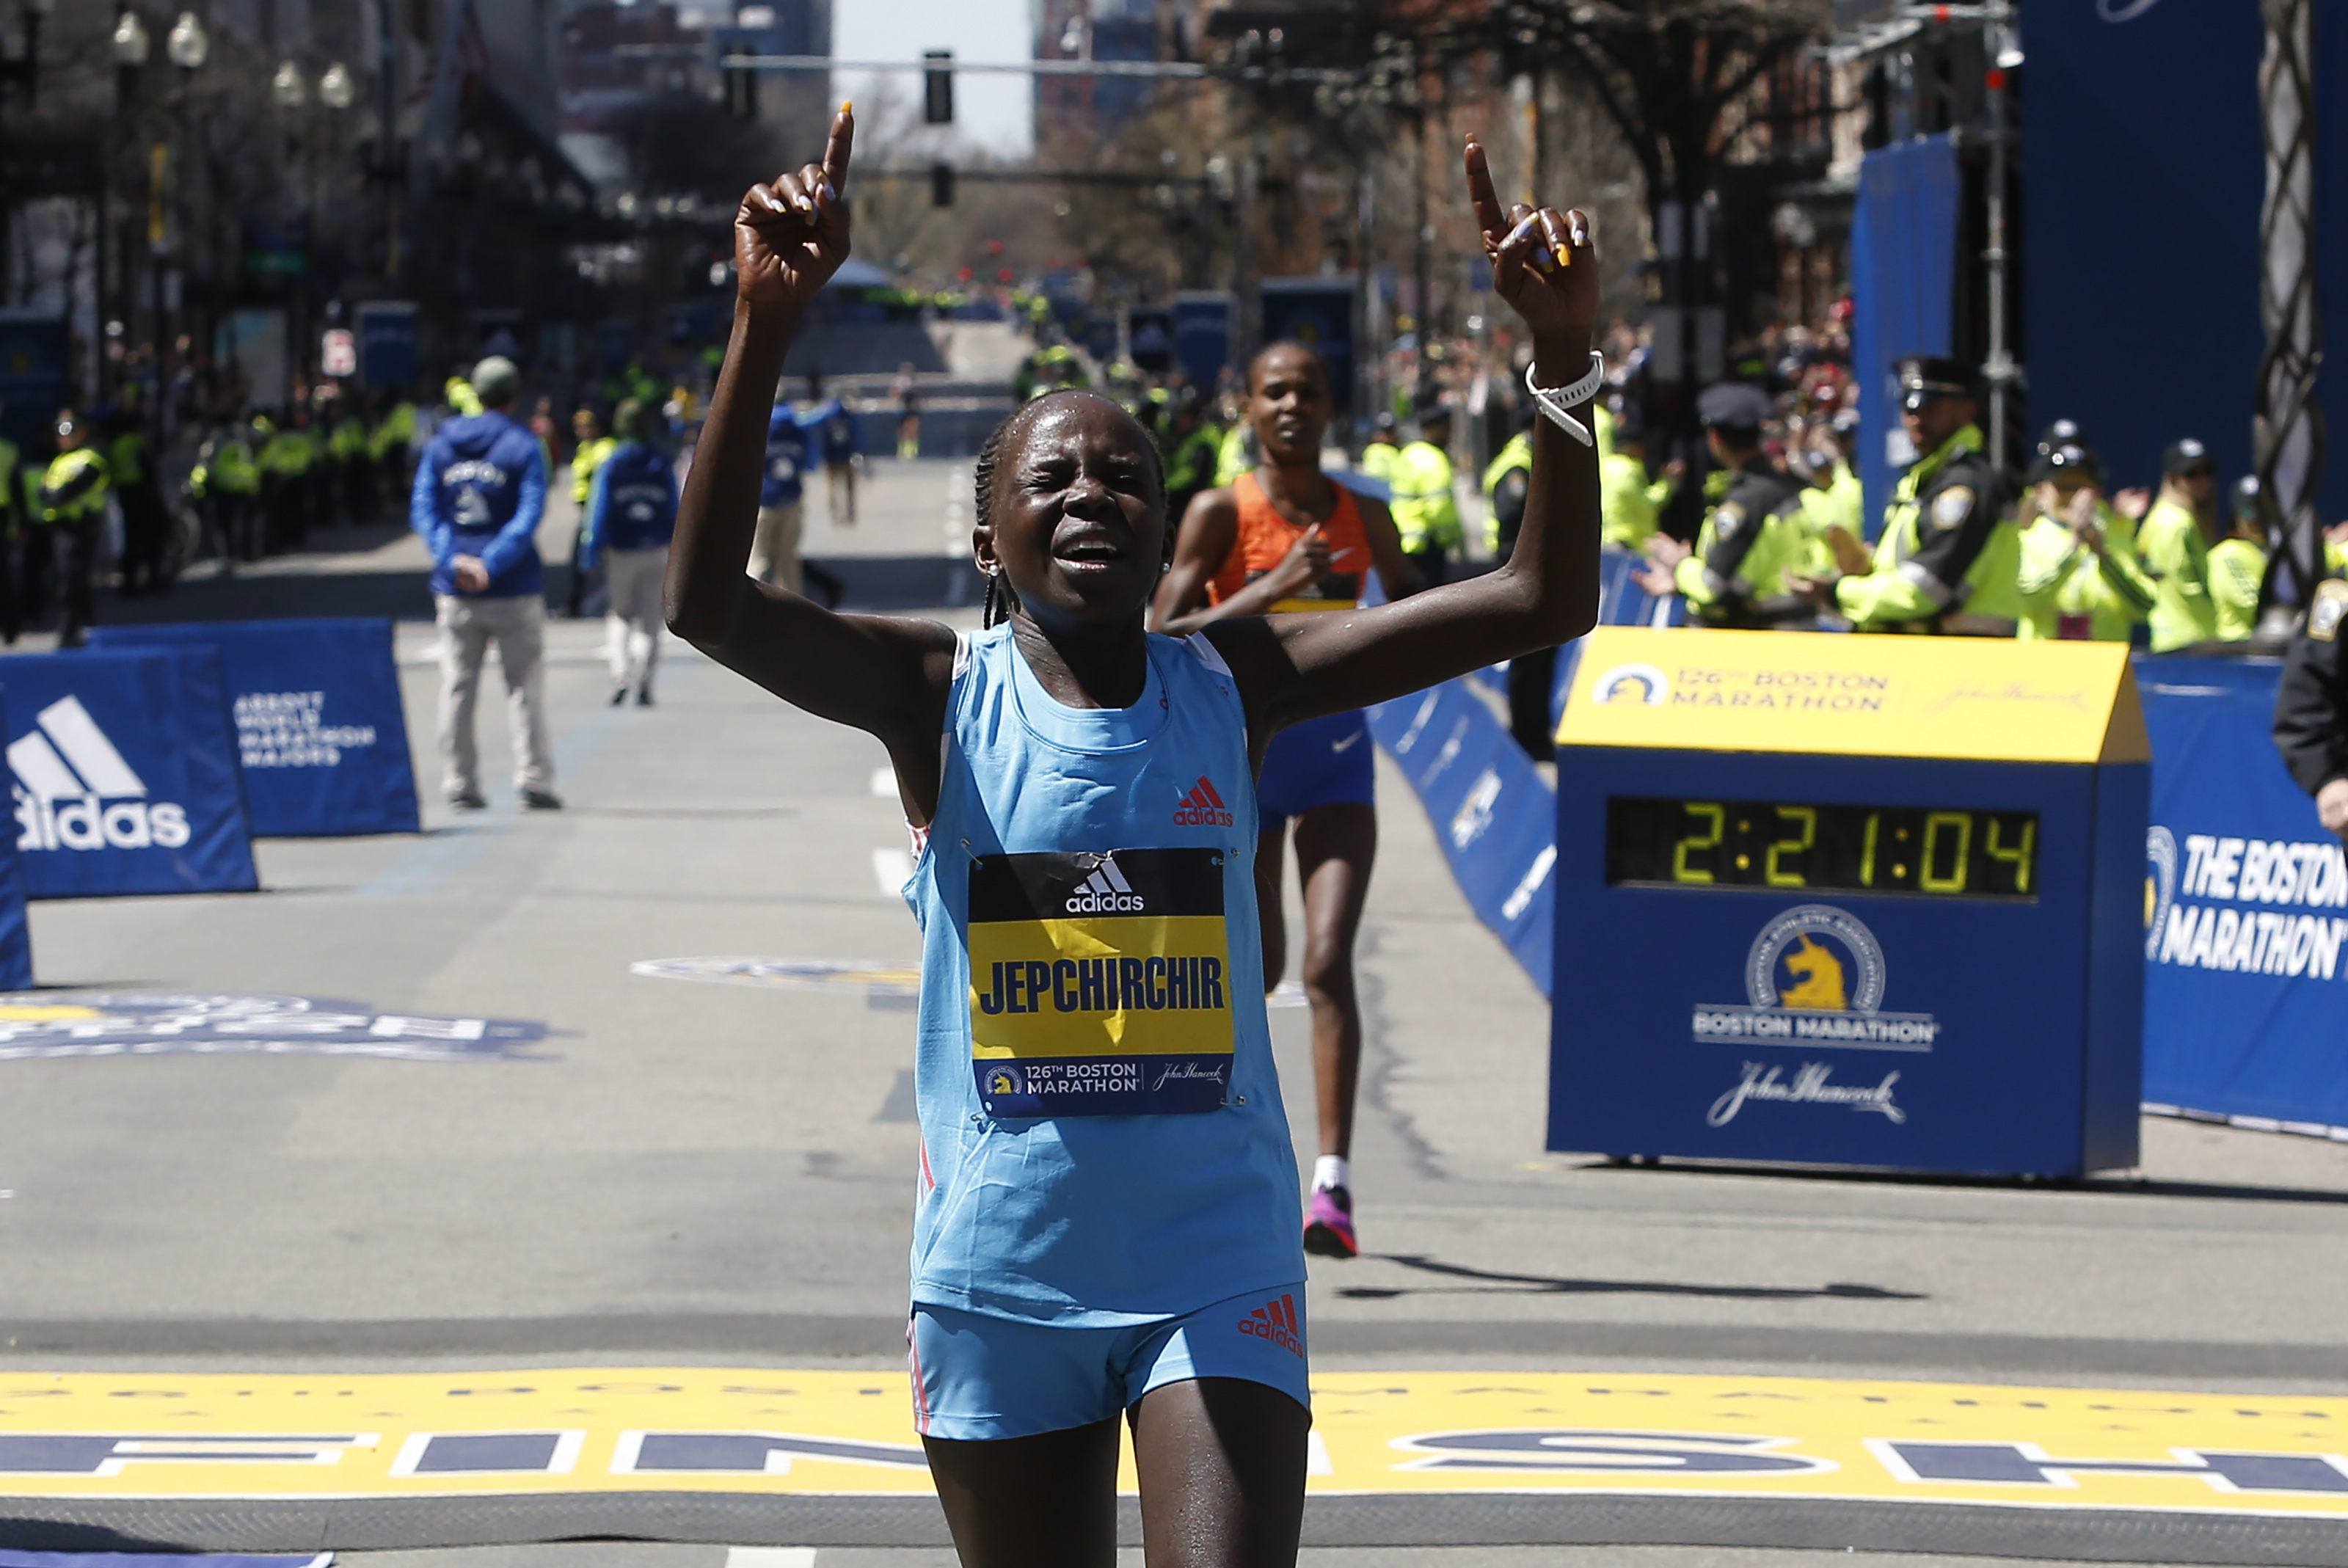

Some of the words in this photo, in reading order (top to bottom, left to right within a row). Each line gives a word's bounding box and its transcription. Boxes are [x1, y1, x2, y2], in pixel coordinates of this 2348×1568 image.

[1754, 671, 1889, 690] BOSTON
[1671, 690, 1884, 712] MARATHON
[14, 792, 191, 851] didas
[1173, 806, 1233, 828] adidas
[1672, 803, 2035, 893] 2:21:04
[2182, 834, 2246, 900] THE
[2237, 839, 2348, 908] BOSTON
[1066, 891, 1145, 913] adidas
[2159, 902, 2344, 980] MARATHON
[980, 956, 1225, 1015] JEPCHIRCHIR
[1693, 1011, 1793, 1038] BOSTON
[1796, 1016, 1936, 1043] MARATHON
[1025, 1065, 1063, 1079] 126TH
[1066, 1063, 1137, 1079] BOSTON
[1027, 1079, 1137, 1095] MARATHON
[1237, 1319, 1304, 1360] adidas
[0, 1426, 2348, 1491] FINSH
